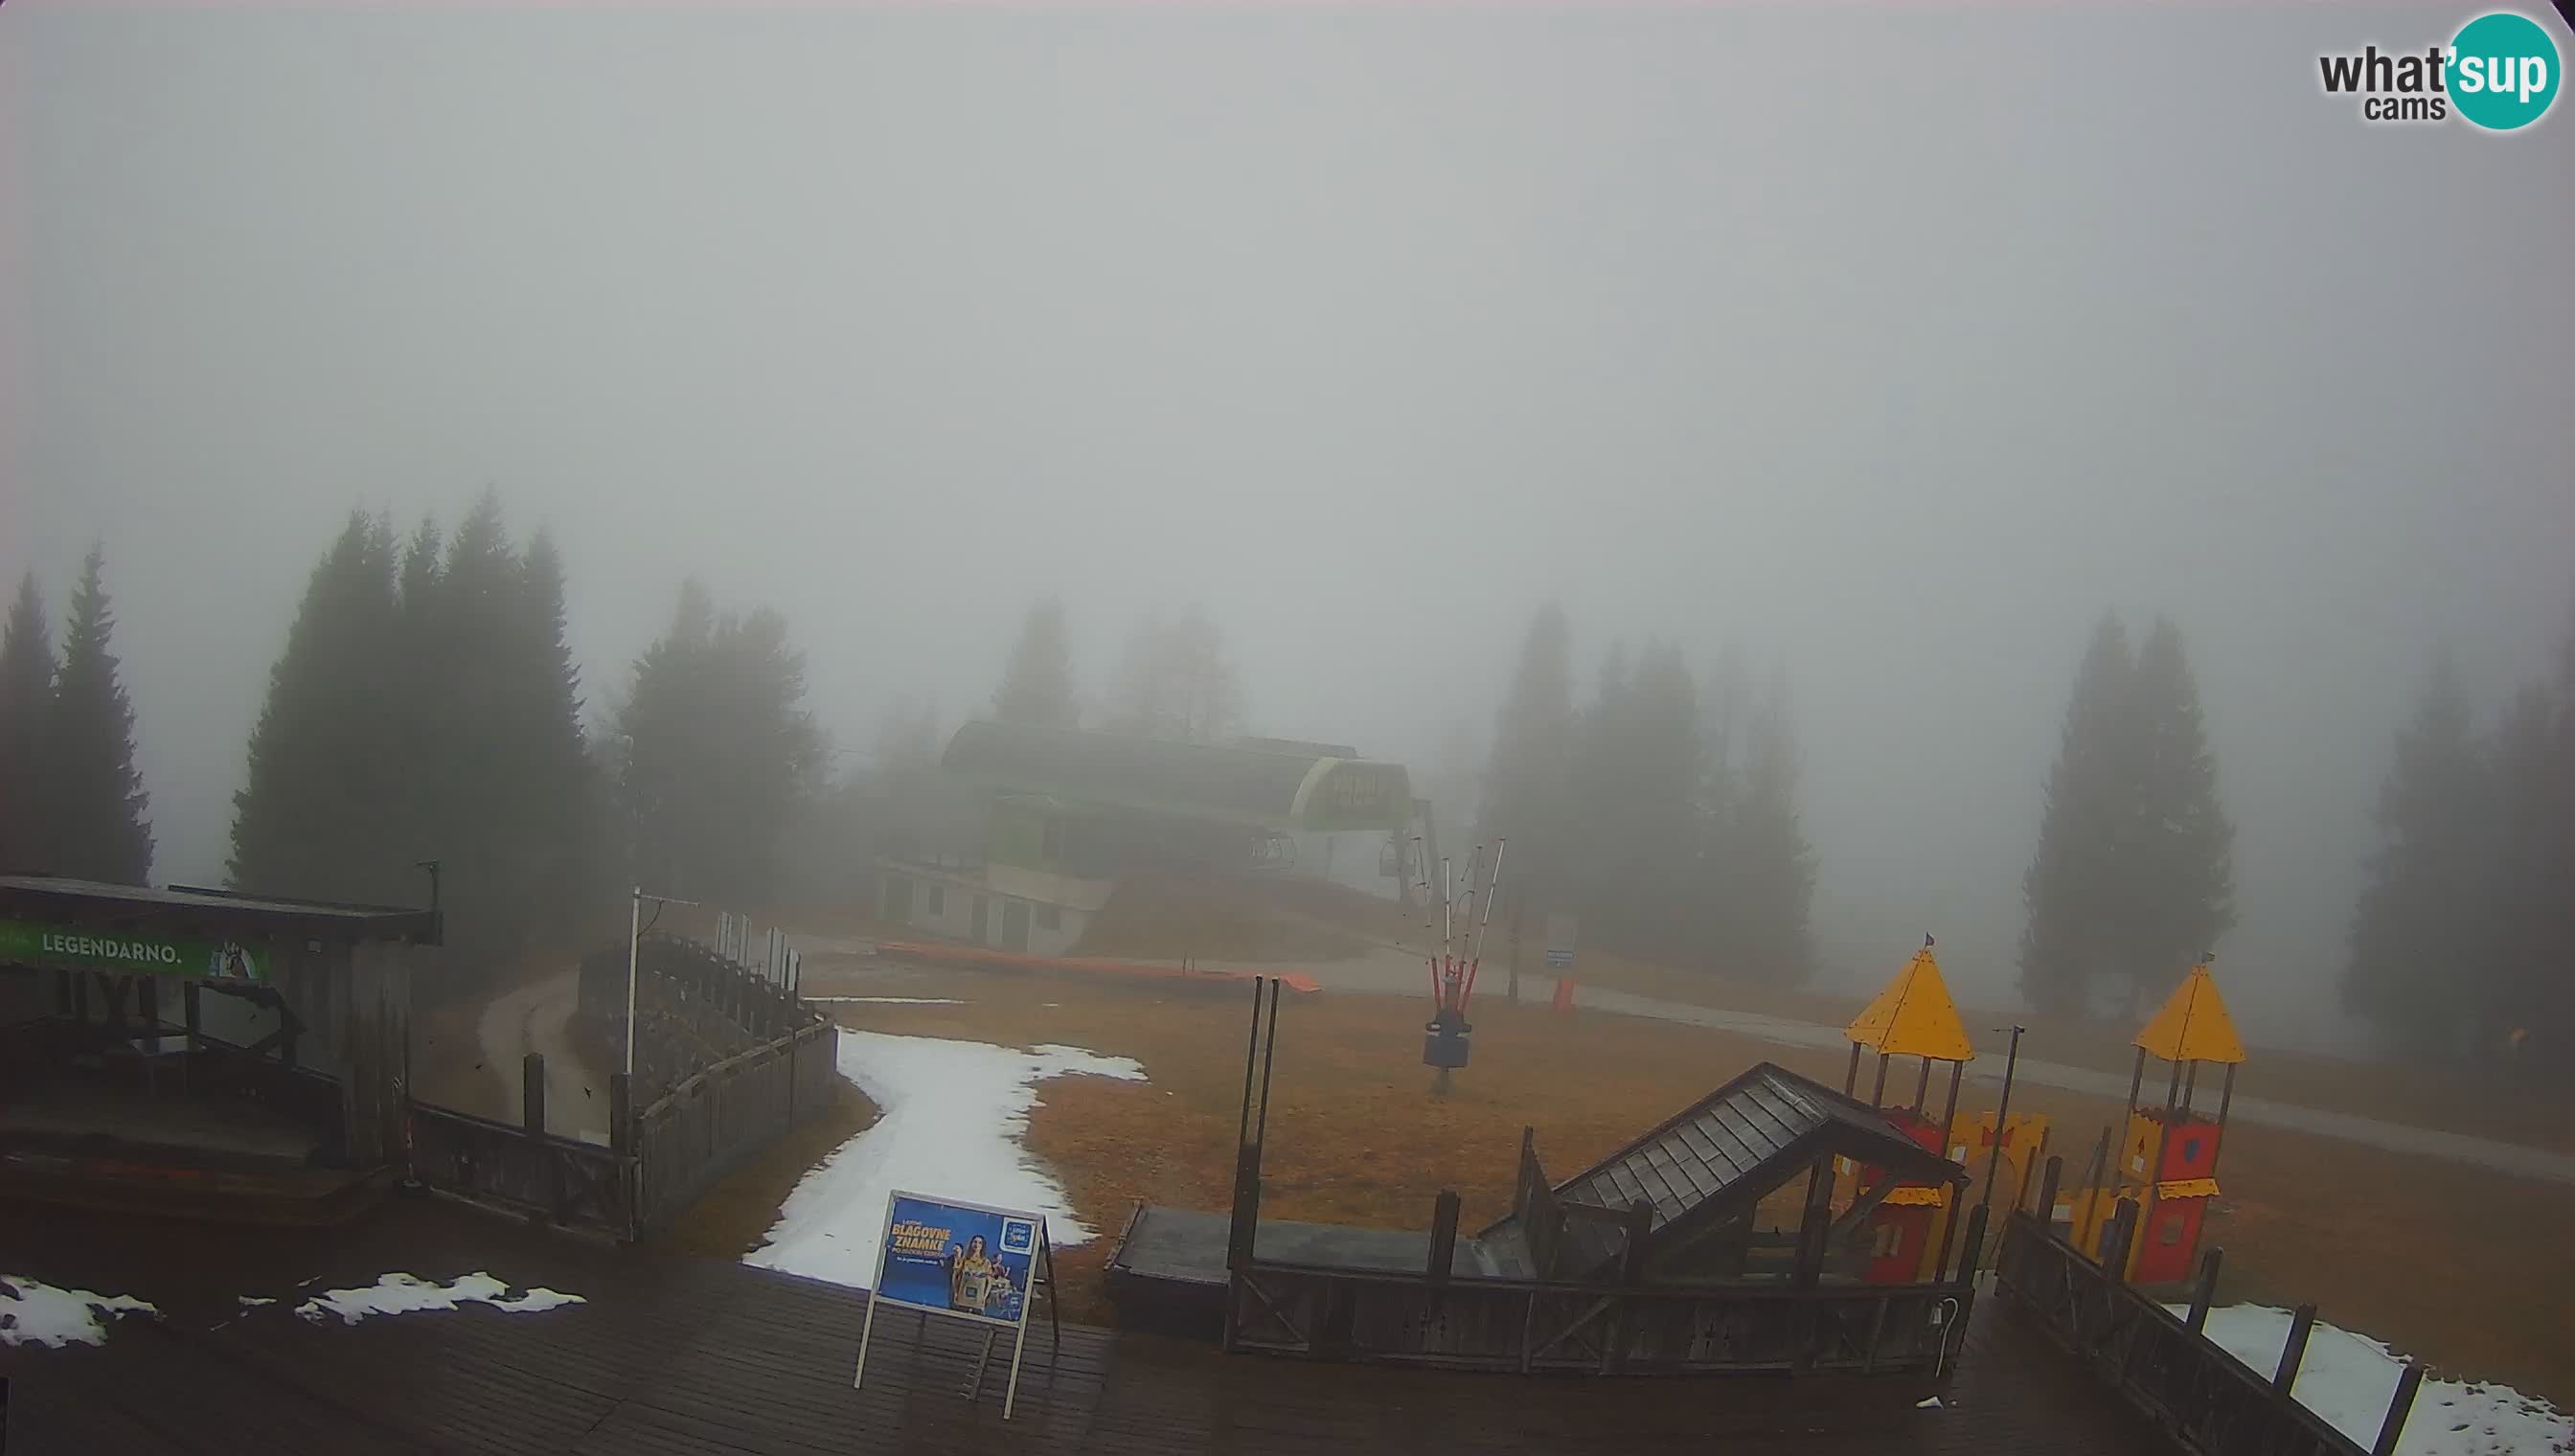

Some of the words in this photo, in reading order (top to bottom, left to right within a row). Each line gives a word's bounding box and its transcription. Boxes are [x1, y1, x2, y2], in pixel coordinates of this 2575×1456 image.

[42, 934, 182, 964] LEGENDARNO.
[892, 1223, 951, 1240] BLAGOVNE
[895, 1236, 945, 1251] ZNAMKE
